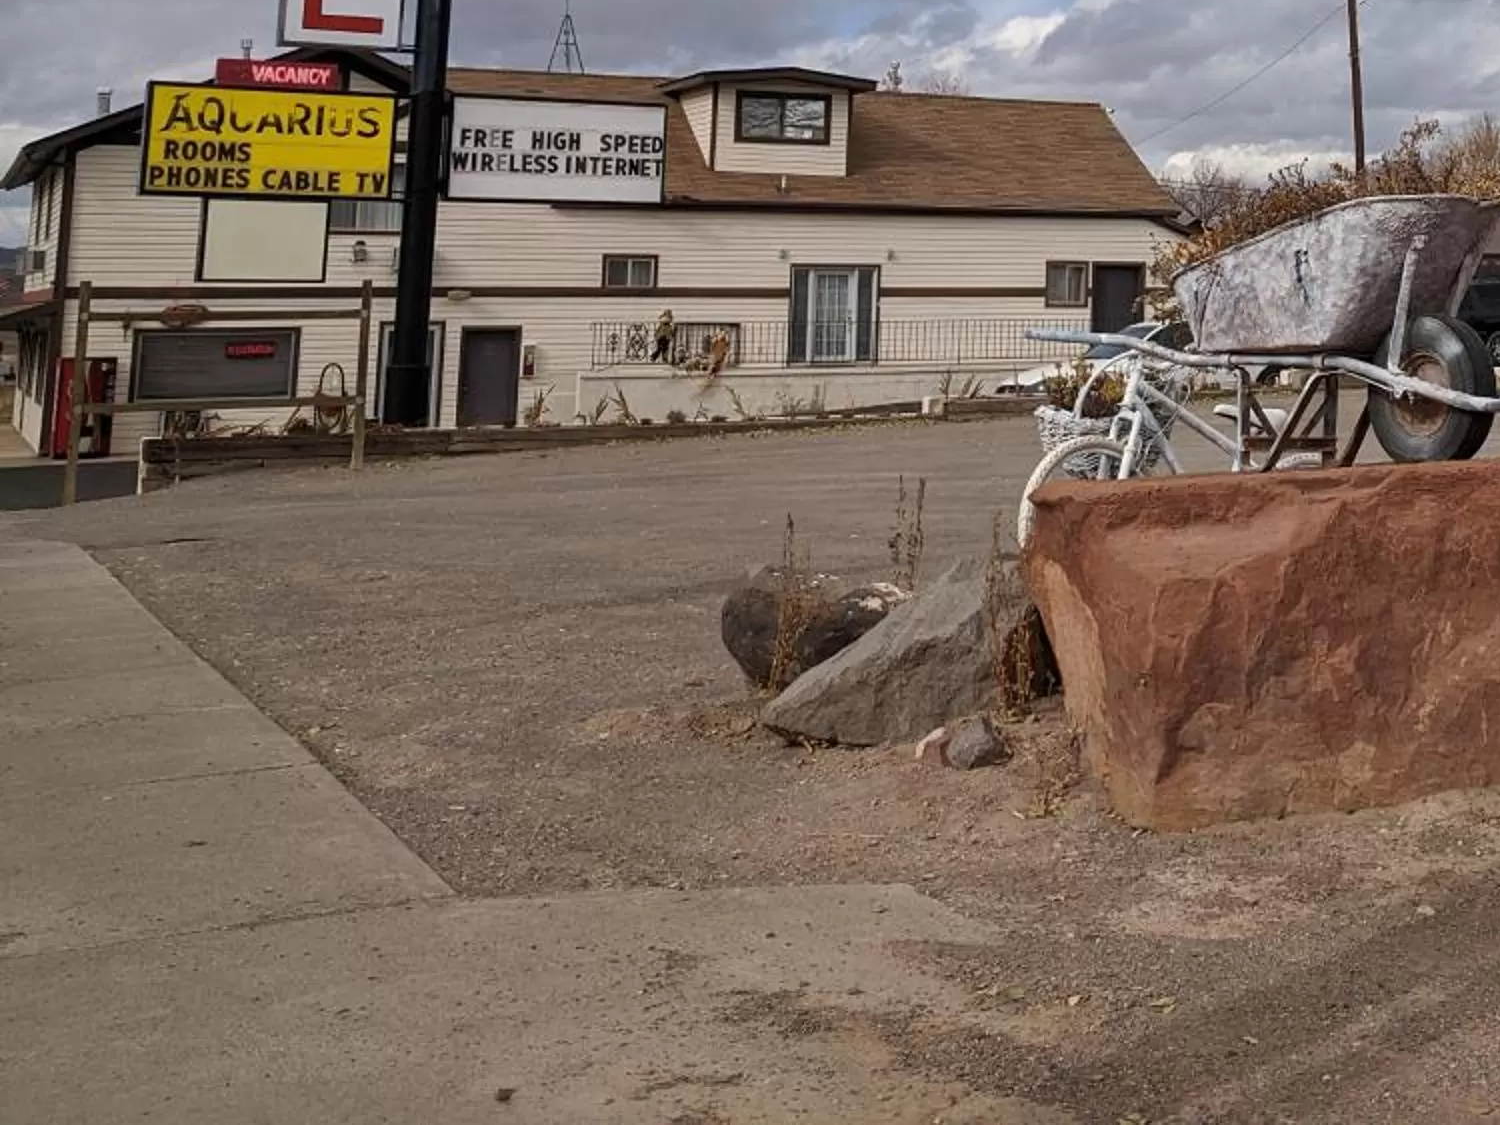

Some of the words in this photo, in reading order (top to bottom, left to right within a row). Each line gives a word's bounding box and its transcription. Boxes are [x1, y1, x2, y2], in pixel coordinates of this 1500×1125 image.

[251, 63, 332, 85] VACANCY
[160, 92, 384, 139] AQUARIUS
[163, 139, 252, 163] ROOMS
[460, 128, 515, 149] FREE
[531, 131, 581, 151] HIGH
[600, 134, 664, 154] SPEED
[451, 151, 559, 174] WIRELESS
[565, 156, 664, 177] INTERNET
[149, 164, 251, 190] PHONES
[262, 169, 341, 192] CABLE
[355, 172, 386, 193] TV
